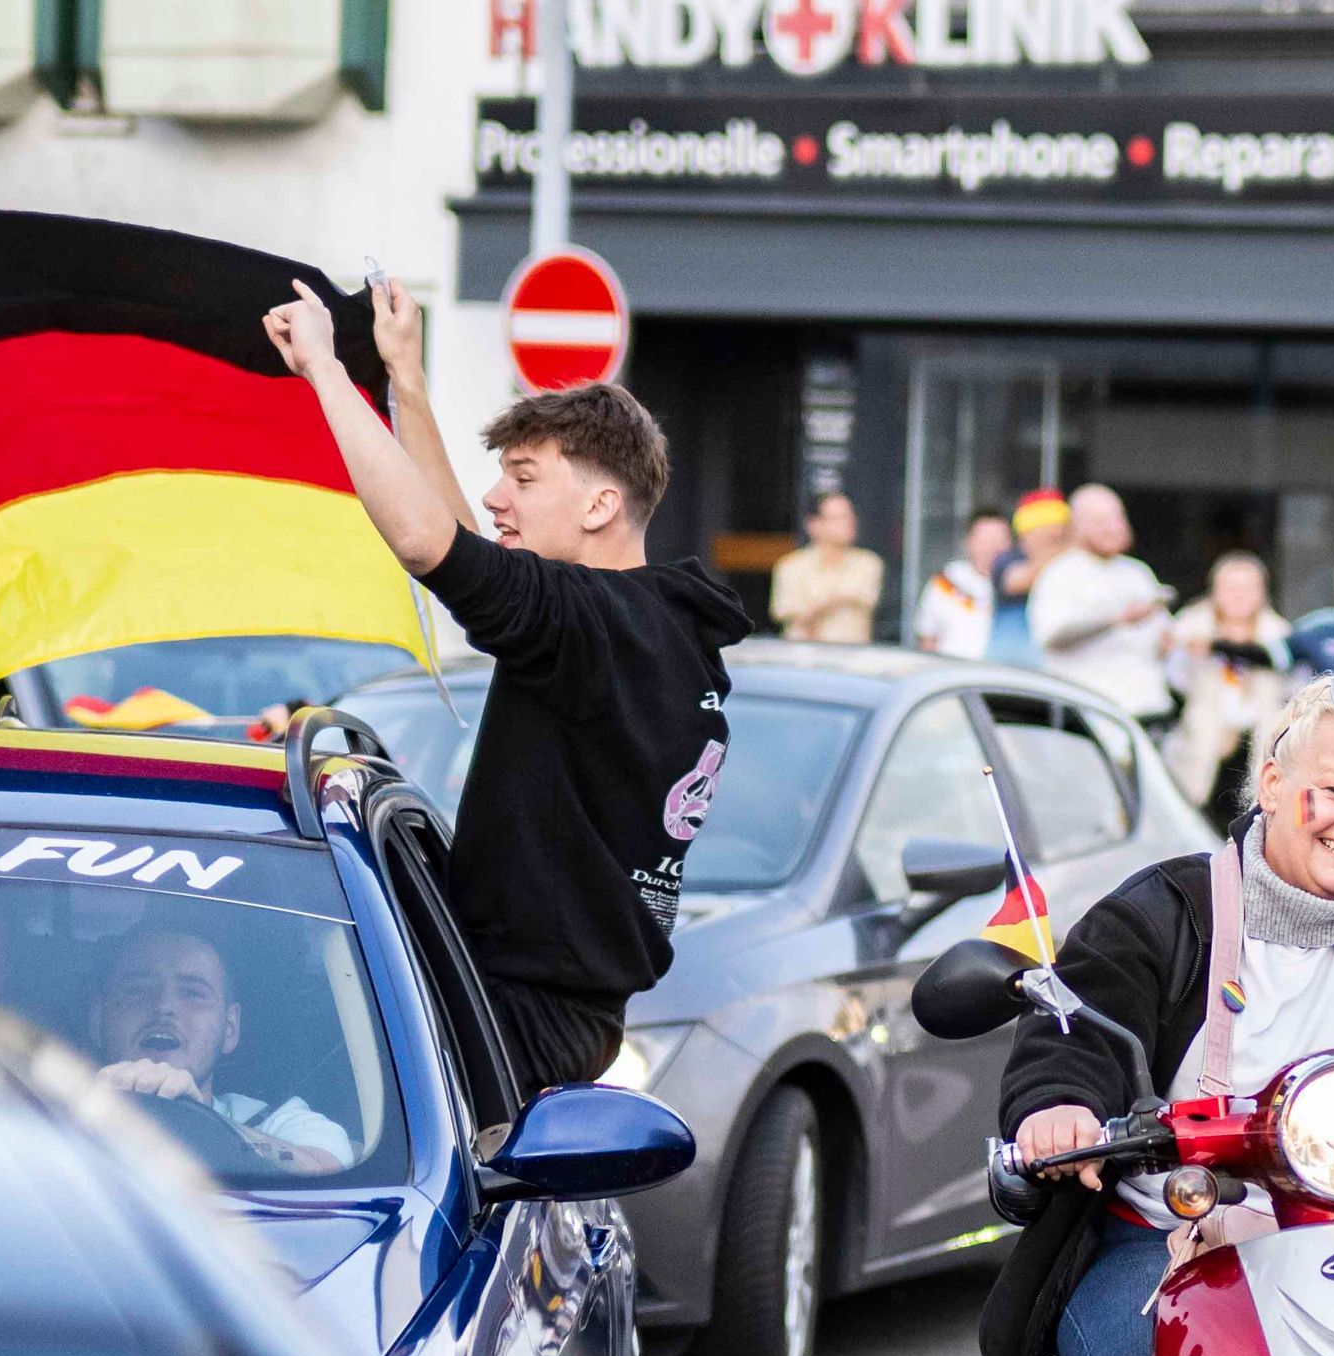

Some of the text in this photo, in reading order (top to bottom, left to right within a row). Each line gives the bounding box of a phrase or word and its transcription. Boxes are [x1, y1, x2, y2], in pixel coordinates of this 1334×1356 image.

[858, 0, 1151, 66] KLINIK
[478, 117, 785, 176] Proessionelle
[825, 117, 1120, 190] Smartphone
